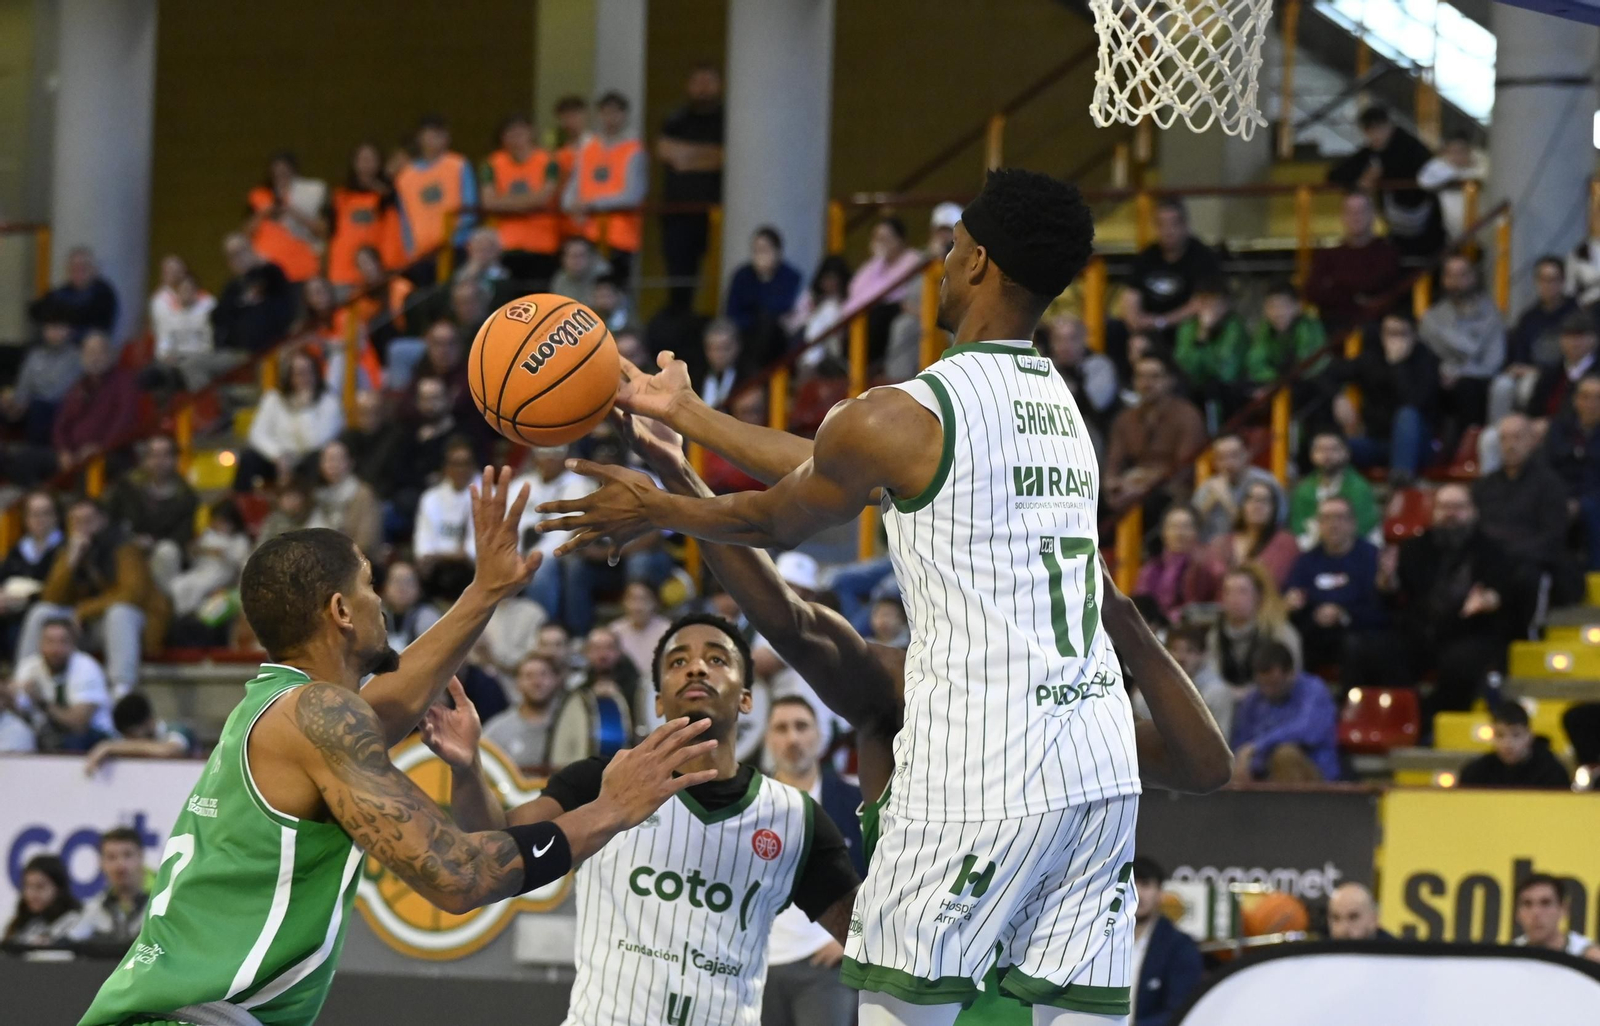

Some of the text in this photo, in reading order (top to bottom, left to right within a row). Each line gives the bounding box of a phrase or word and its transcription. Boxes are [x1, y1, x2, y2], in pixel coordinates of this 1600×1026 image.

[520, 308, 600, 375] Wilson
[1013, 400, 1078, 439] SAGNIA
[1040, 536, 1098, 659] 17
[629, 865, 733, 913] coto
[617, 939, 679, 963] Fundación
